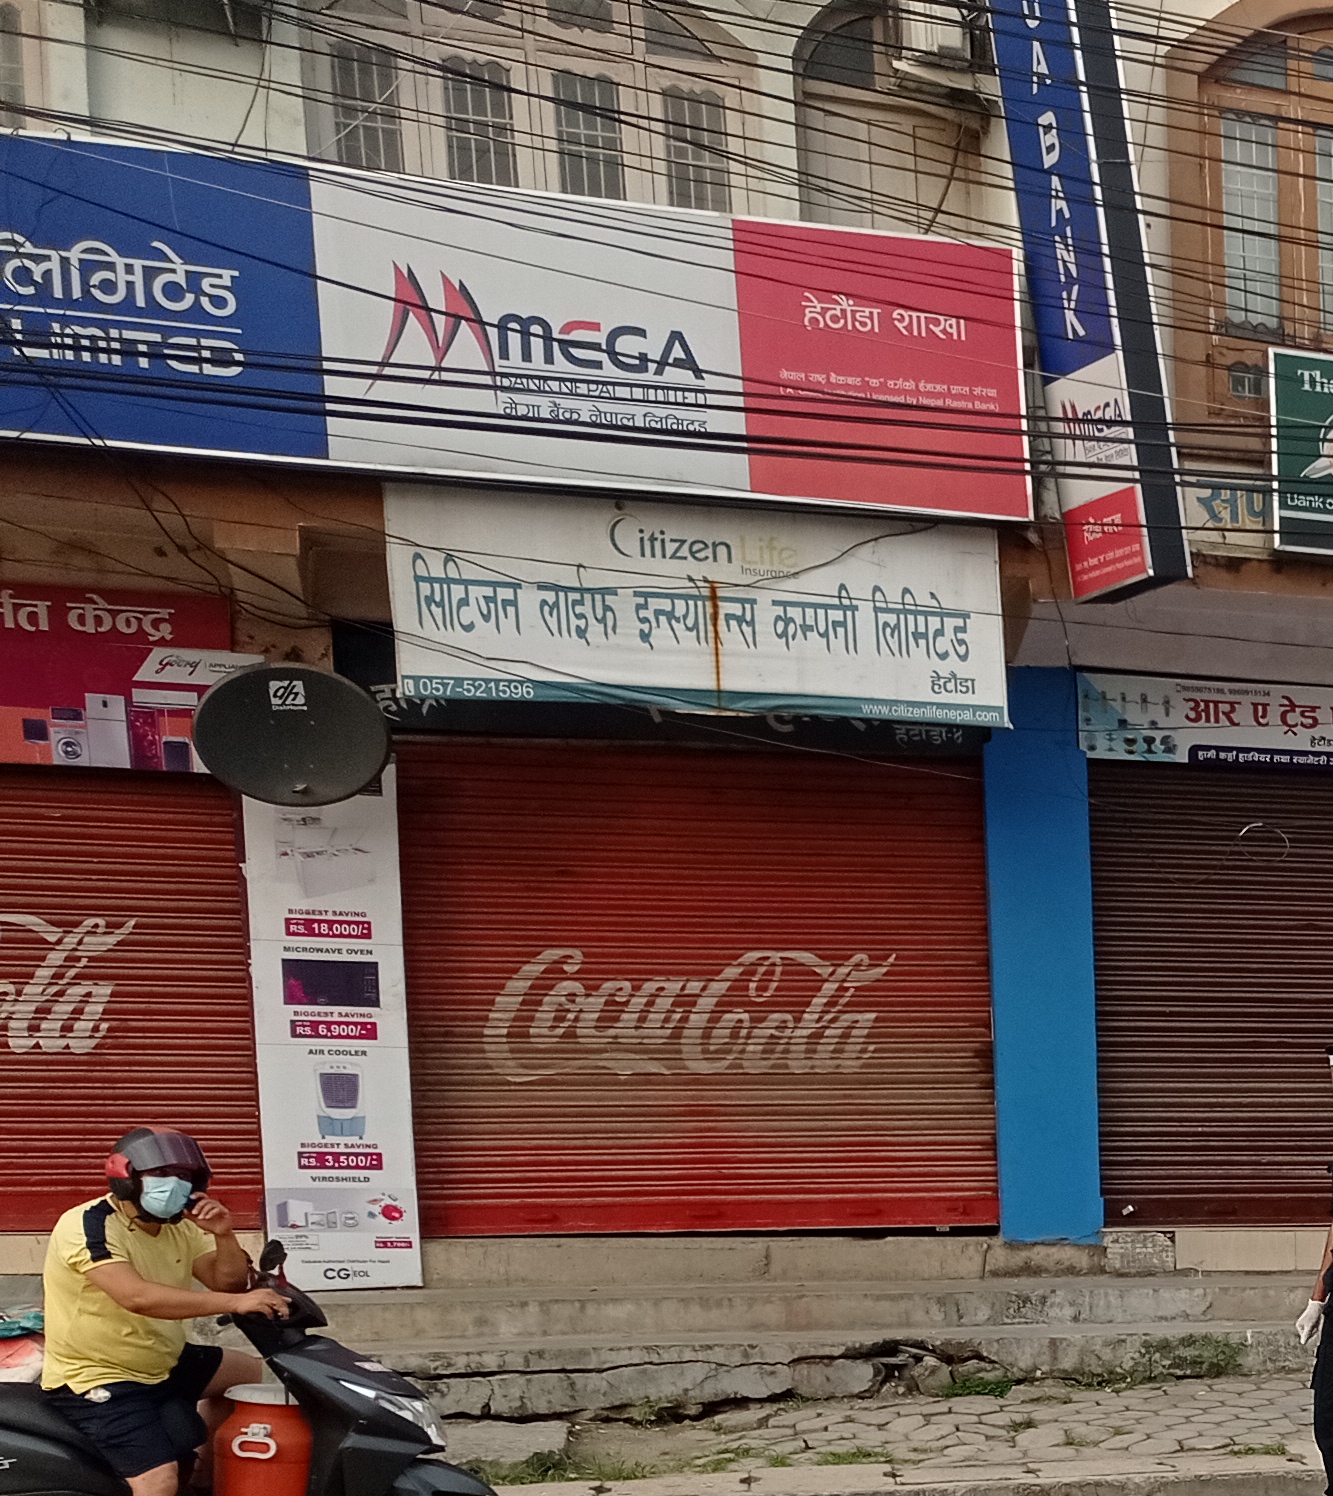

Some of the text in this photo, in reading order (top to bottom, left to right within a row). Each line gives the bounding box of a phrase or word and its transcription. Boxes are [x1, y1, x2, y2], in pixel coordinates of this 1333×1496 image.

[893, 308, 966, 341] शाखा
[608, 516, 732, 564] Citizen
[412, 552, 522, 637] सिटिजन
[772, 583, 859, 656] कम्पनी
[872, 585, 971, 662] लिमिटेड
[66, 594, 175, 642] केन्द्र
[420, 678, 534, 698] 057-521596
[861, 703, 1000, 722] www.citizenlifenepal.com
[1183, 697, 1241, 727] आर
[1250, 700, 1271, 727] ए
[1279, 696, 1320, 736] ट्रेड
[288, 908, 367, 918] BIGGEST SAVING
[283, 945, 374, 956] MICROWAVE OVEN
[293, 1010, 374, 1019] BIGGEST SAVING
[308, 1048, 368, 1057] AIR COOLER
[300, 1142, 378, 1150] BIGGEST SAVING
[310, 1175, 371, 1184] VIROSHIELD
[323, 1267, 351, 1280] CG
